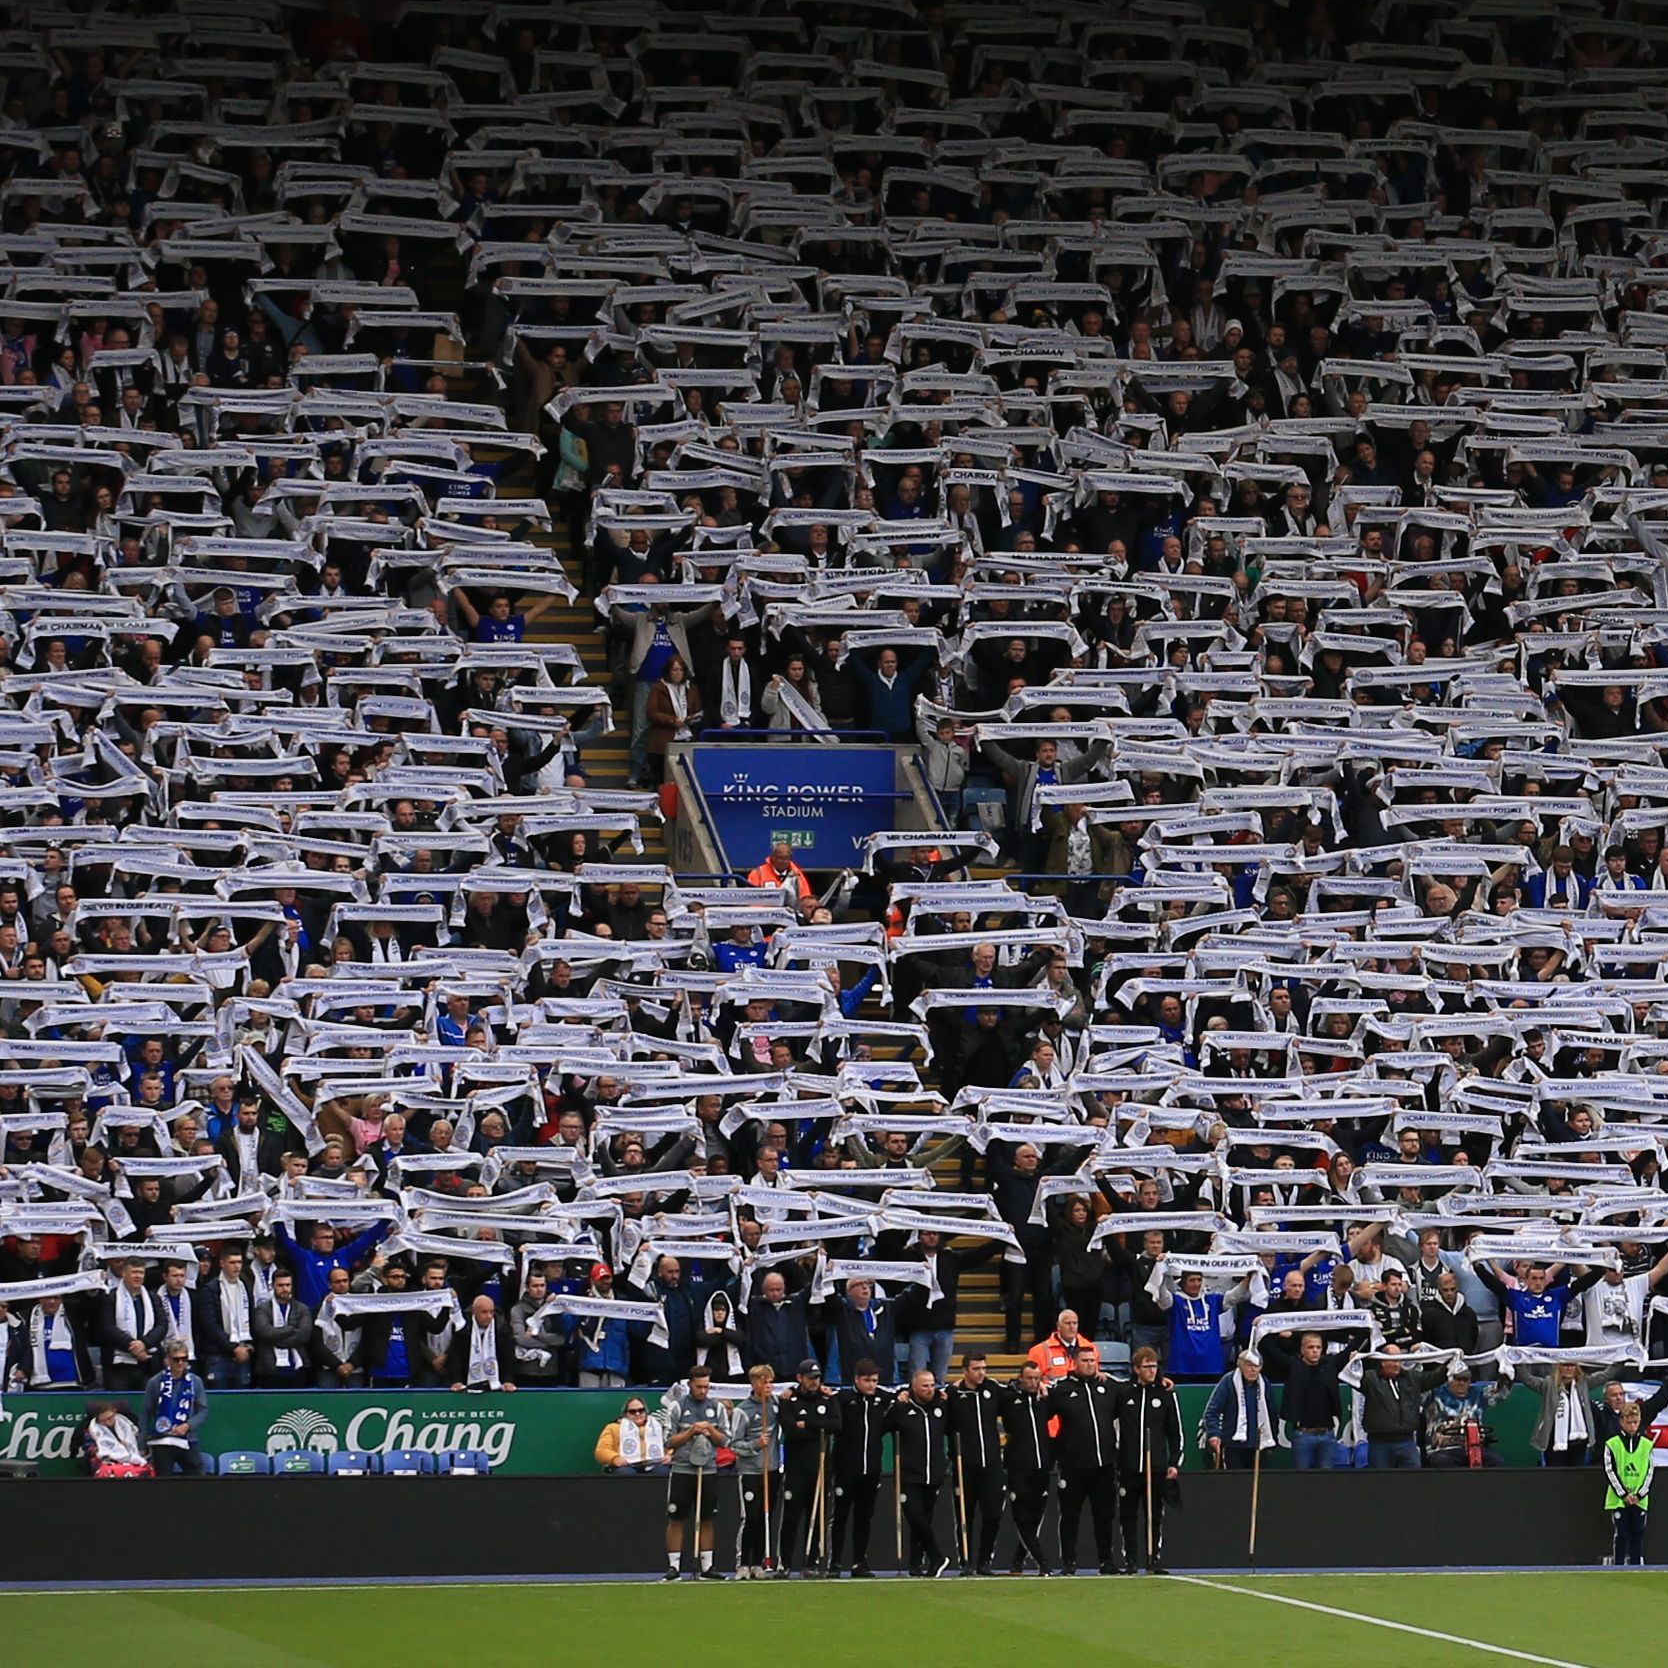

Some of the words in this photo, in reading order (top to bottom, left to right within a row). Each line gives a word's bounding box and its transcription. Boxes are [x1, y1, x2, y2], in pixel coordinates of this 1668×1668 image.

[494, 633, 516, 641] KING
[1070, 725, 1101, 733] POSSIBLE
[723, 785, 779, 802] KING
[787, 785, 863, 802] POWER
[762, 805, 824, 818] STADIUM
[1493, 806, 1522, 814] POSSIBLE
[902, 832, 956, 841] CHAIRMAN
[1593, 1036, 1603, 1044] IN
[1549, 1084, 1573, 1092] VICHAI
[1366, 1152, 1391, 1161] KING
[882, 1173, 913, 1181] POSSIBLE
[839, 1221, 869, 1230] POSSIBLE
[980, 1224, 1010, 1234] POSSIBLE
[121, 1244, 177, 1253] CHAIRMAN
[1201, 1259, 1210, 1268] IN
[1212, 1260, 1228, 1268] OUR
[1335, 1314, 1368, 1322] POSSIBLE
[48, 1413, 89, 1421] LAGE
[422, 1411, 466, 1419] LAGER
[470, 1411, 505, 1419] BEER
[345, 1406, 516, 1467] Chang
